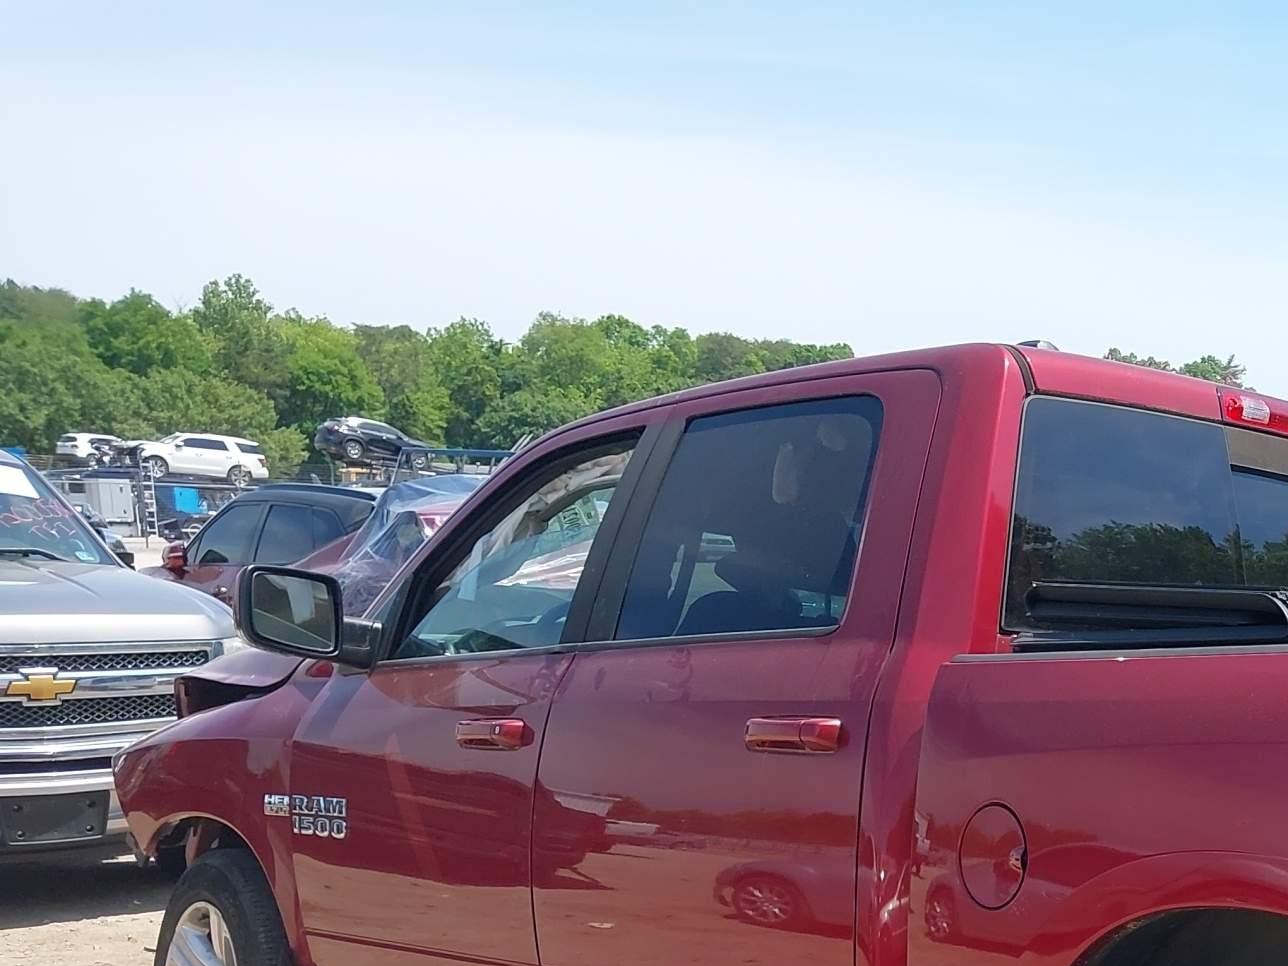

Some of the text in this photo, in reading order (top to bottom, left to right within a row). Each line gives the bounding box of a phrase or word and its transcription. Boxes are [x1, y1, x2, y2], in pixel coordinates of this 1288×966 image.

[264, 794, 290, 805] HE
[291, 795, 347, 817] RAM
[292, 816, 347, 839] 1500
